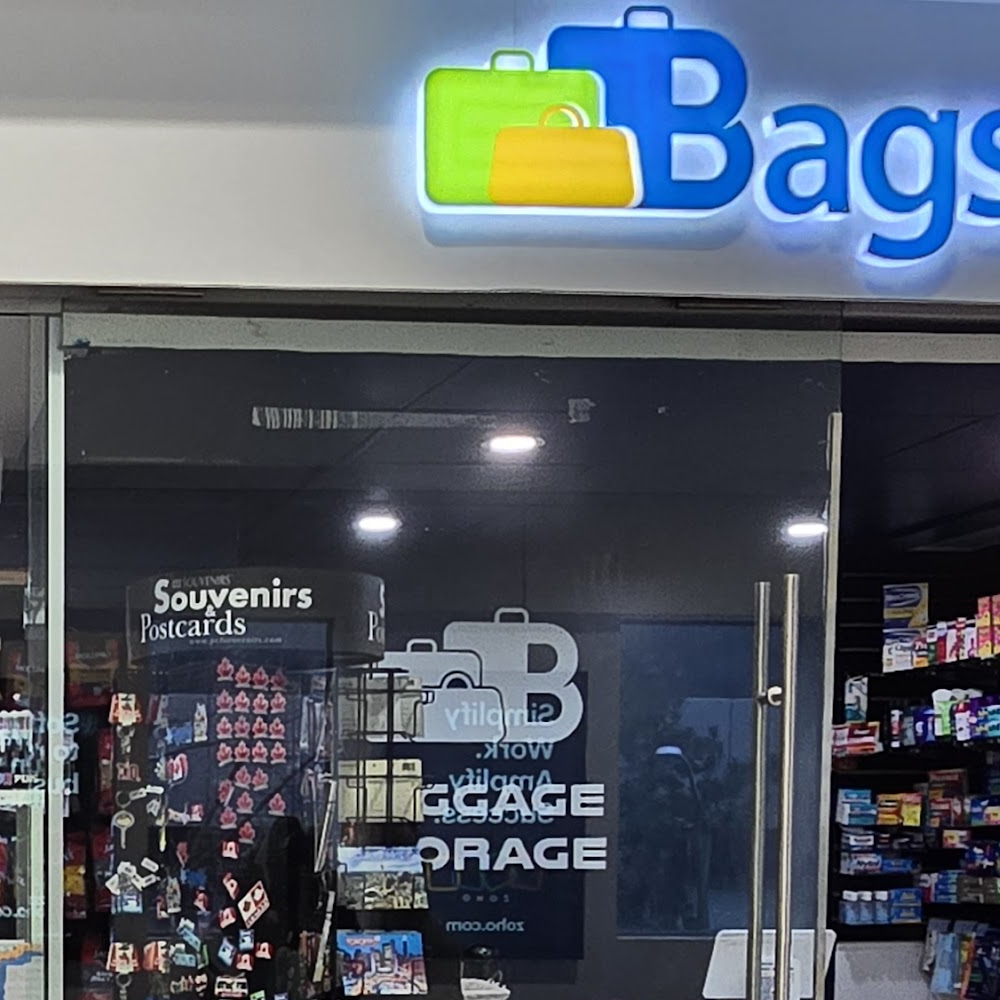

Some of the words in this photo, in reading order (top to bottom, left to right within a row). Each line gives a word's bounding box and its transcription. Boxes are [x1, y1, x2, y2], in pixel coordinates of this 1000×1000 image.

[153, 577, 314, 614] Souvenirs
[205, 604, 217, 617] &
[140, 609, 248, 644] Postcards
[421, 783, 605, 816] GGAGE
[416, 836, 608, 870] ORAGE
